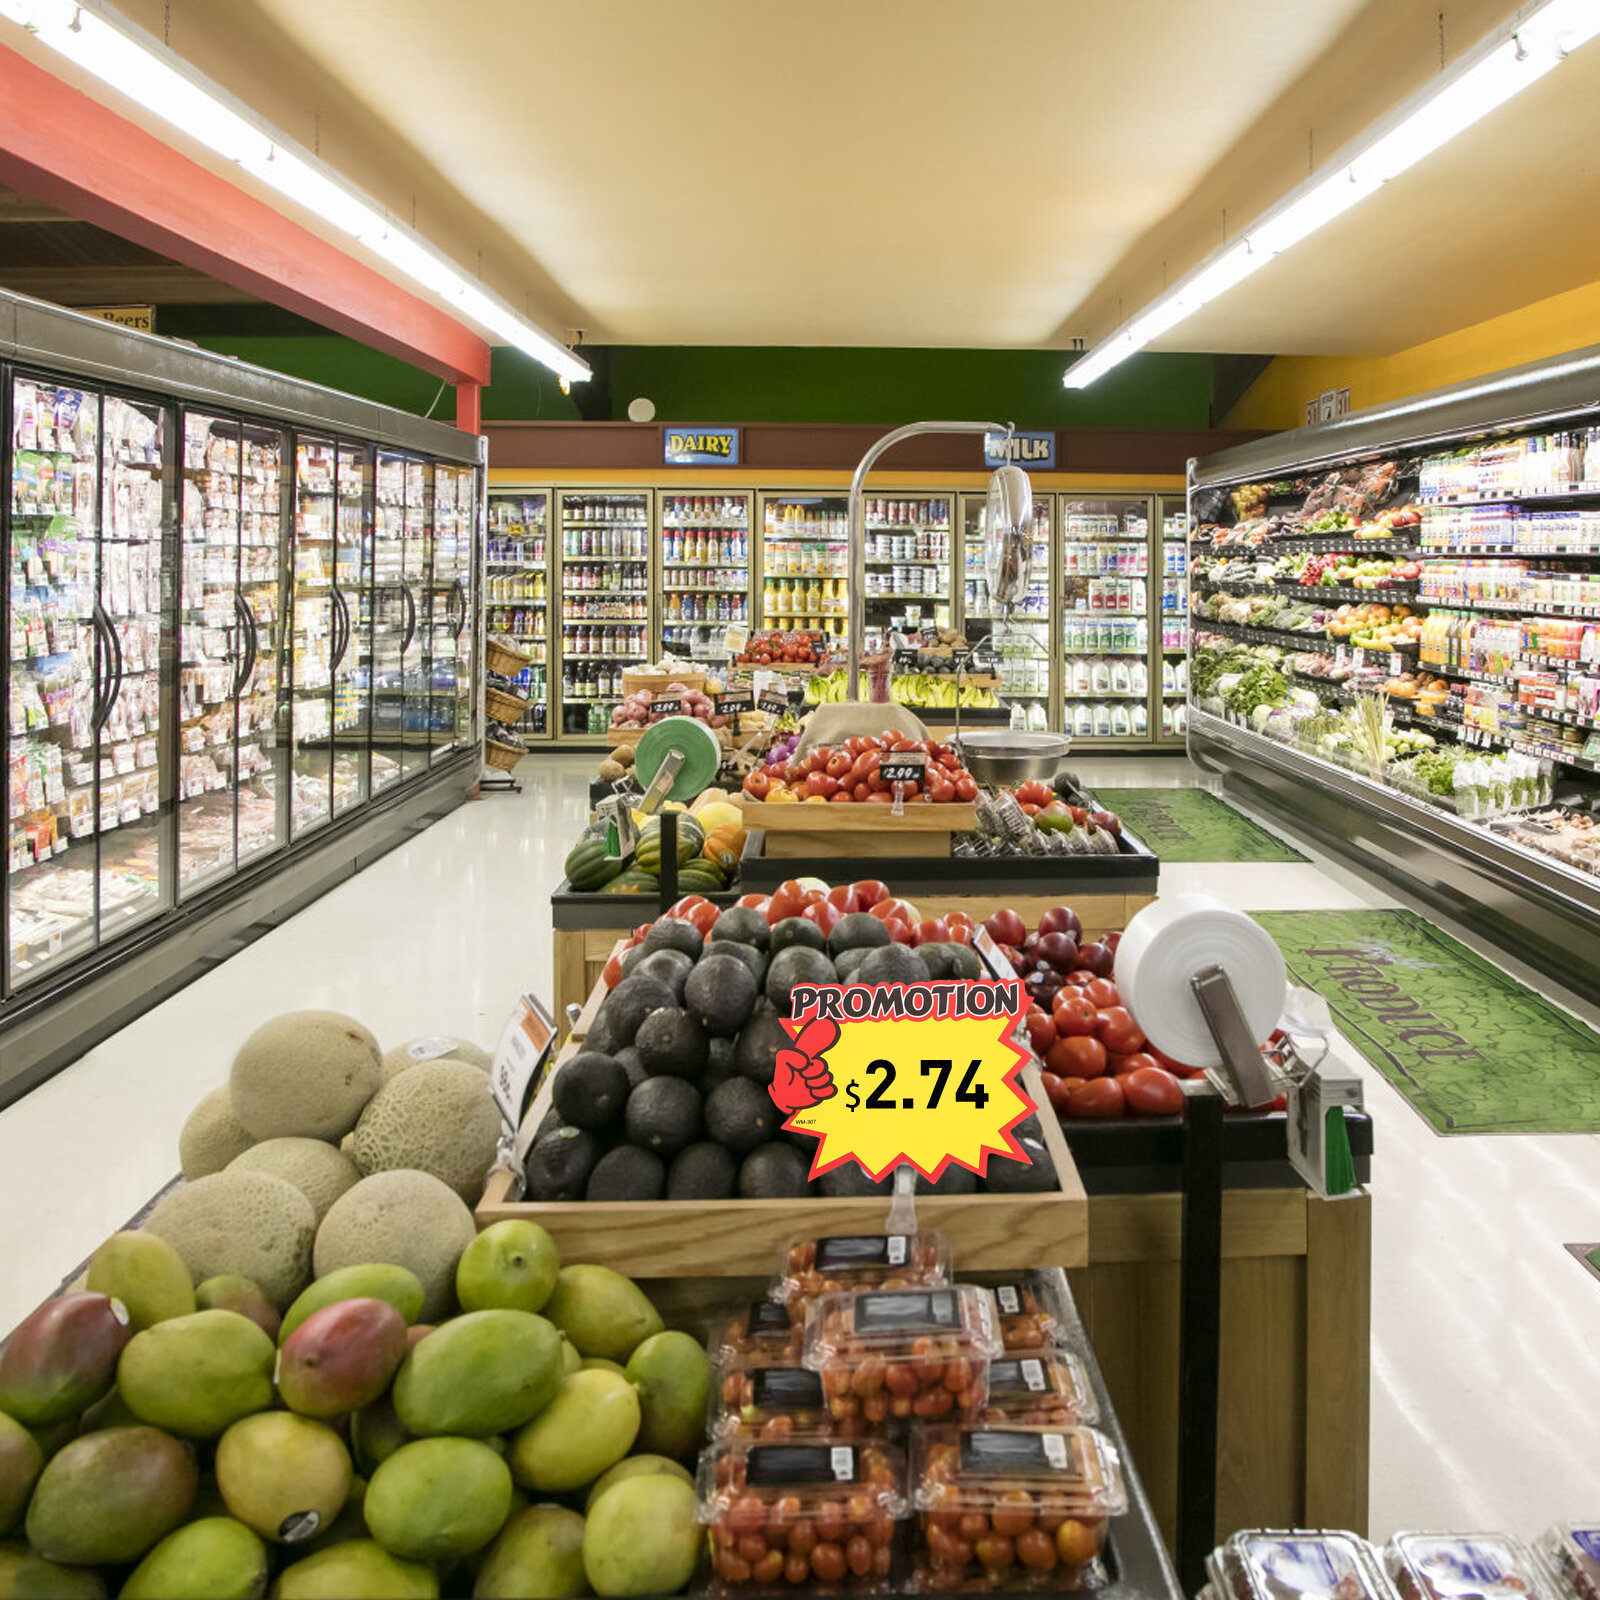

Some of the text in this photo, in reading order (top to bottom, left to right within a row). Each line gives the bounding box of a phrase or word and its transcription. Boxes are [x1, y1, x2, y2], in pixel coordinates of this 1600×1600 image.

[669, 433, 733, 457] DAIRY
[988, 436, 1050, 461] MILK
[791, 982, 1019, 1020] PROMOTION
[1304, 948, 1490, 1066] PRODUCE
[845, 1059, 989, 1112] $2.74
